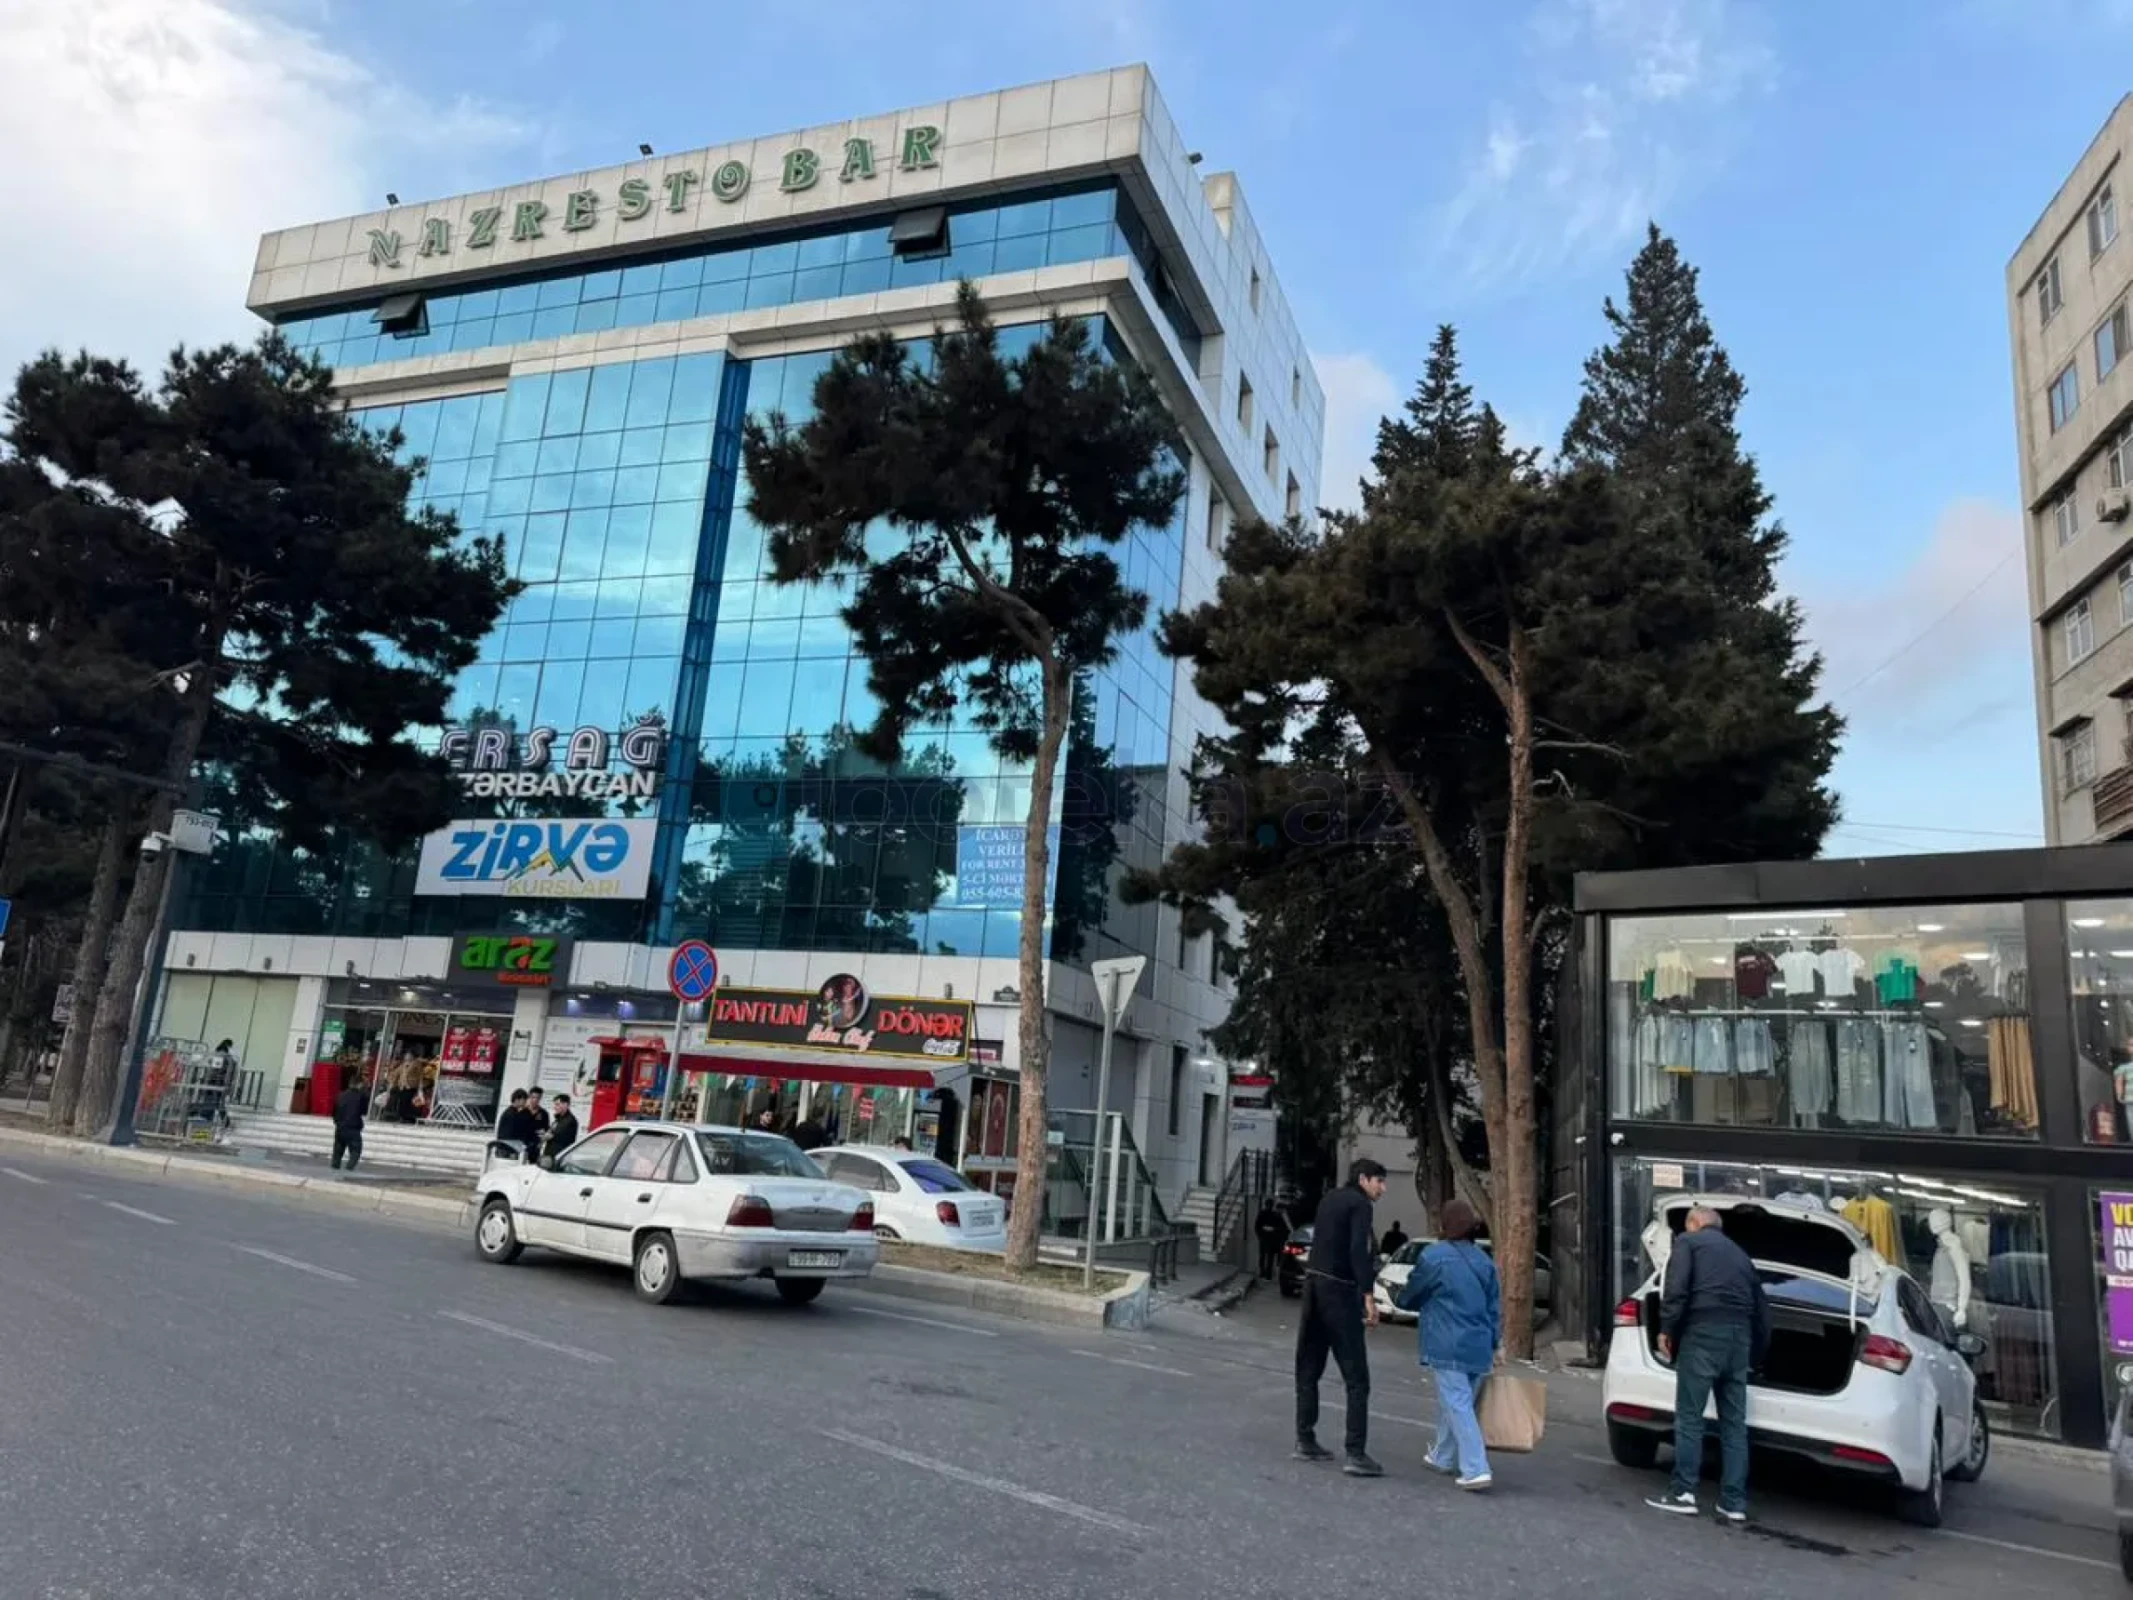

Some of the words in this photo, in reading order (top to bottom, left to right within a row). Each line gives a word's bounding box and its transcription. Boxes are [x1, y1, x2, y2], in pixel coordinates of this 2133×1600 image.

[458, 771, 656, 799] ZƏRBAYCAN
[976, 828, 1027, 841] İCARƏY
[461, 936, 555, 970] araz
[877, 1006, 965, 1039] DÖNƏR
